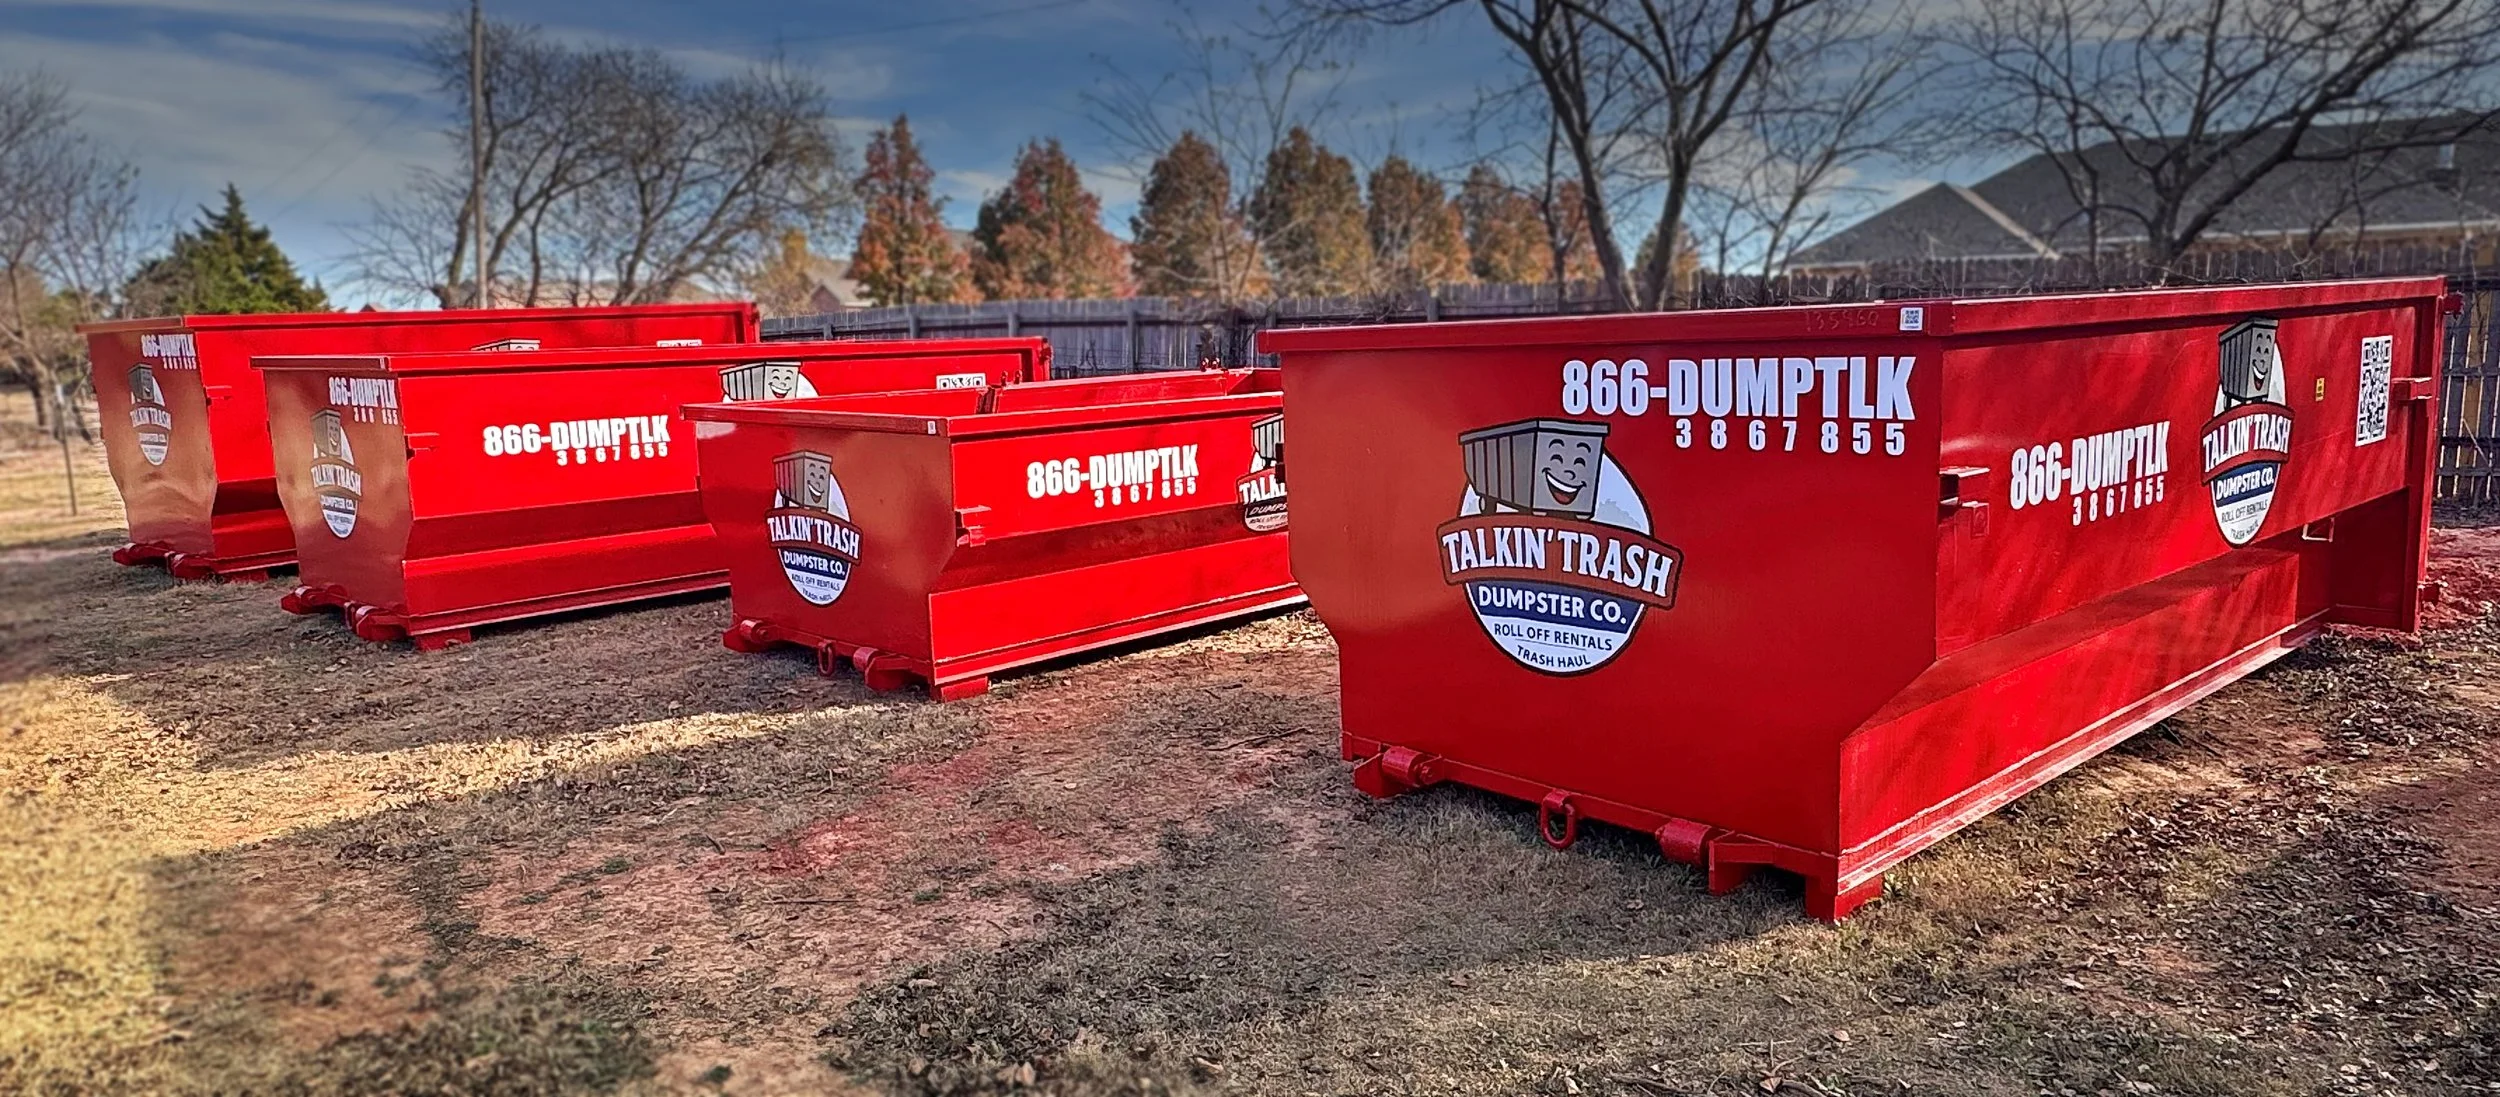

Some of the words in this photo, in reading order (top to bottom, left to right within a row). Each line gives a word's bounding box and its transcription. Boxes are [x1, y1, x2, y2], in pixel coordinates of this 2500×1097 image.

[328, 376, 398, 408] 866-DUMPTLK
[1562, 356, 1917, 421] 866-DUMPTLK
[483, 414, 671, 457] 866-DUMPTLK
[2253, 413, 2292, 454] TRASH
[1027, 443, 1199, 499] 866-DUMPTLK
[2010, 420, 2171, 510] 866-DUMPTLK
[2216, 468, 2261, 500] DUMPSTER
[767, 514, 814, 542] TALKIN'
[815, 519, 860, 559] TRASH
[784, 550, 829, 572] DUMPSTER
[829, 561, 846, 576] CO.
[1442, 527, 1554, 574] TALKIN'
[1557, 530, 1674, 598] TRASH
[1478, 586, 1585, 618] DUMPSTER
[1590, 601, 1627, 625] CO.
[1494, 623, 1524, 638] ROLL
[1526, 627, 1550, 642] OFF
[1554, 631, 1613, 651] RENTALS
[1517, 645, 1554, 667] TRASH
[1557, 654, 1591, 668] HAUL
